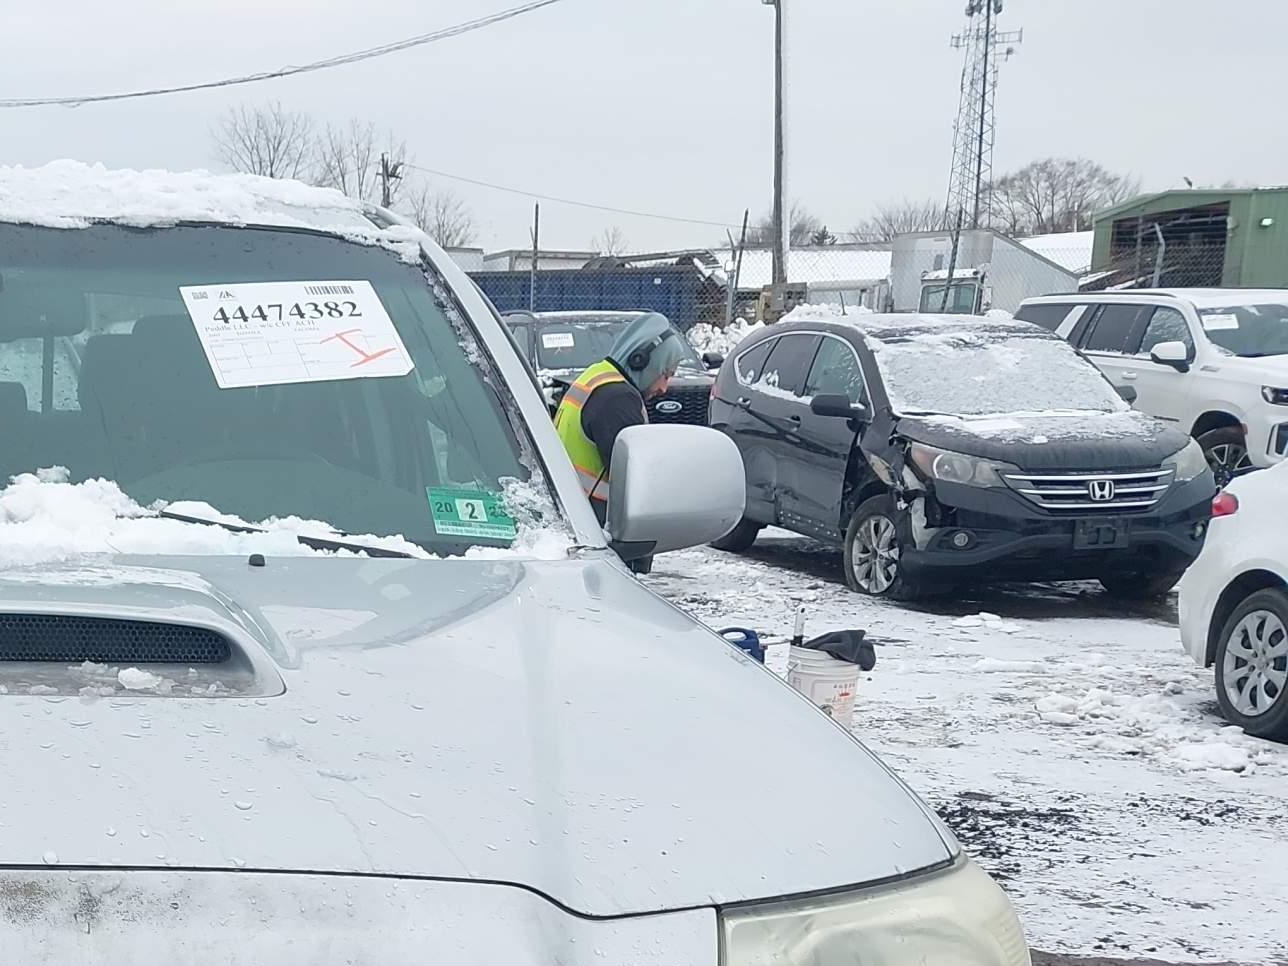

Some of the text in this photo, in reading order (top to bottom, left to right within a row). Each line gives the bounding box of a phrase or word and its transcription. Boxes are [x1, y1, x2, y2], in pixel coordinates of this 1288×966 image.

[212, 300, 362, 324] 44474382
[434, 501, 453, 513] 20
[465, 502, 479, 519] 2
